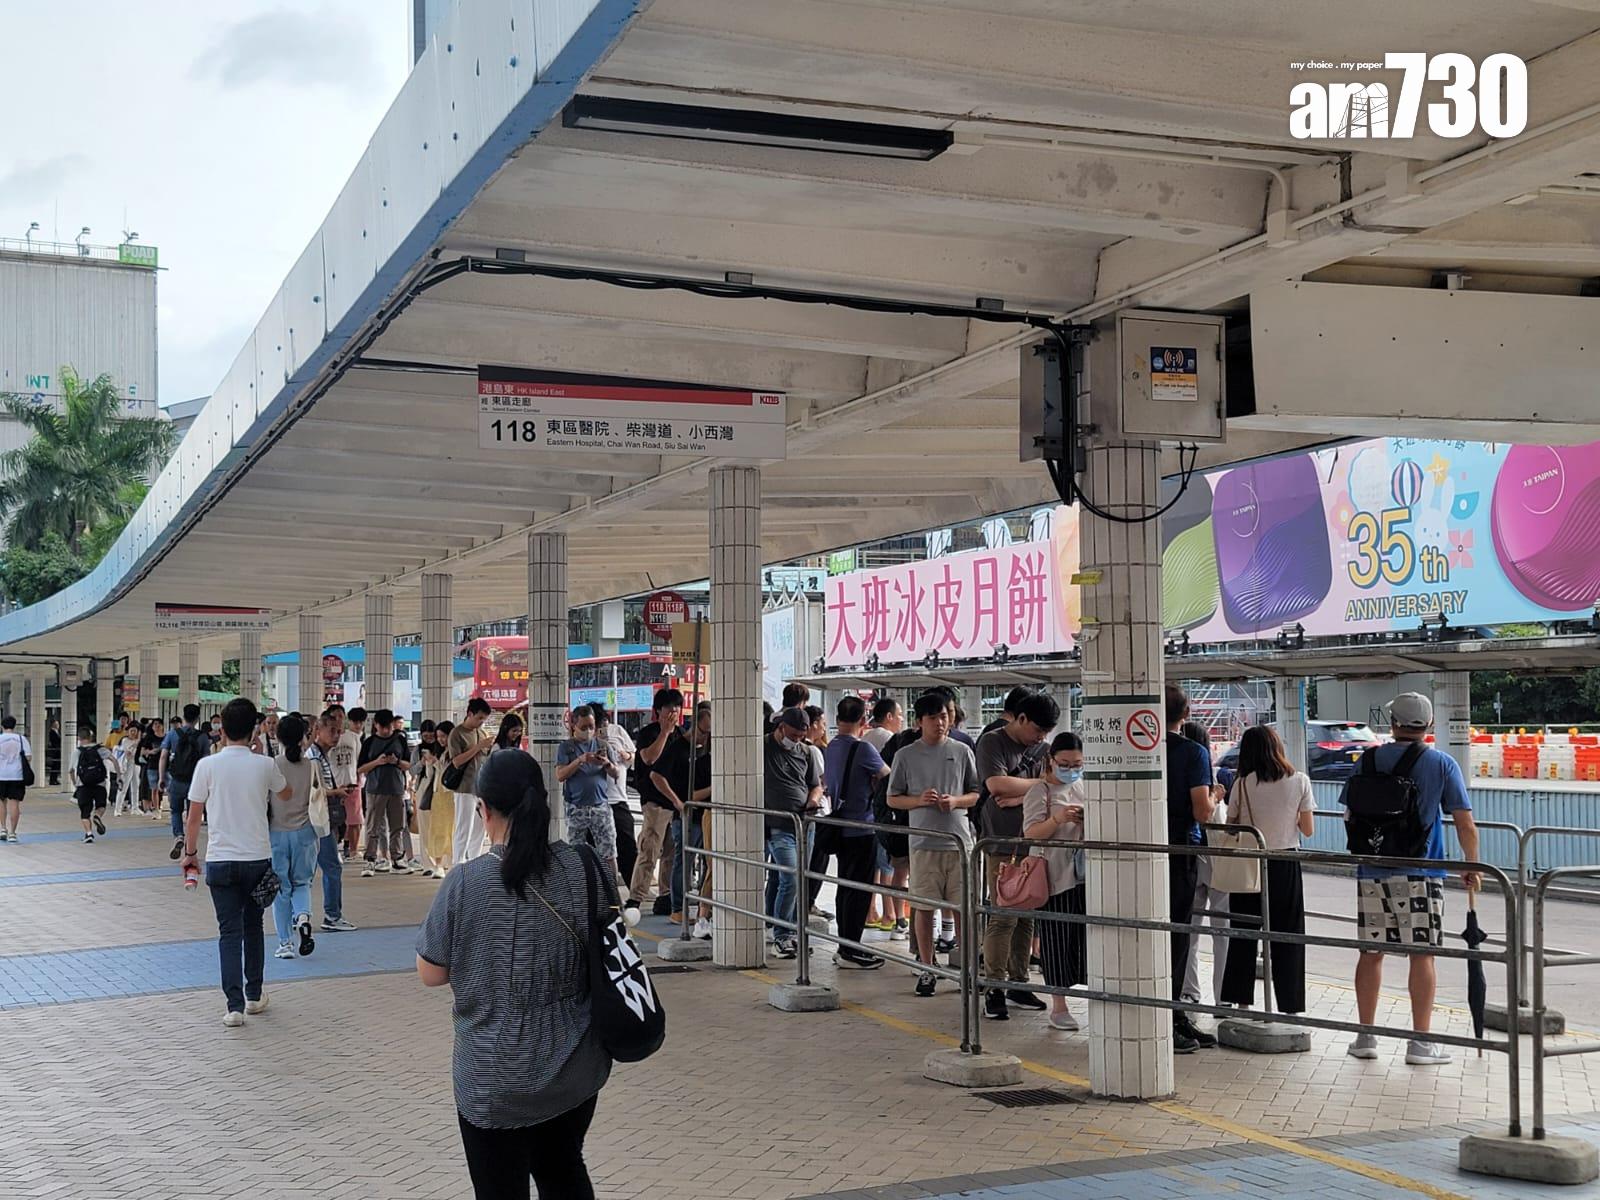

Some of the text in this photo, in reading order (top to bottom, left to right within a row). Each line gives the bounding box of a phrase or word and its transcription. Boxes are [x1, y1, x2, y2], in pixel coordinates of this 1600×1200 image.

[482, 383, 514, 395] 港島東
[517, 387, 527, 395] HK
[529, 388, 549, 396] Island
[491, 419, 536, 442] 118
[546, 438, 574, 447] Eastern
[575, 439, 605, 448] Hospital,
[607, 440, 623, 448] Chai
[642, 441, 663, 450] Road,
[664, 442, 676, 450] Siu
[690, 443, 706, 451] Wan
[1348, 507, 1450, 589] 35 th
[827, 550, 1048, 660] 大班冰皮月餅
[1345, 590, 1469, 622] ANNIVERSARY
[661, 664, 677, 676] A5
